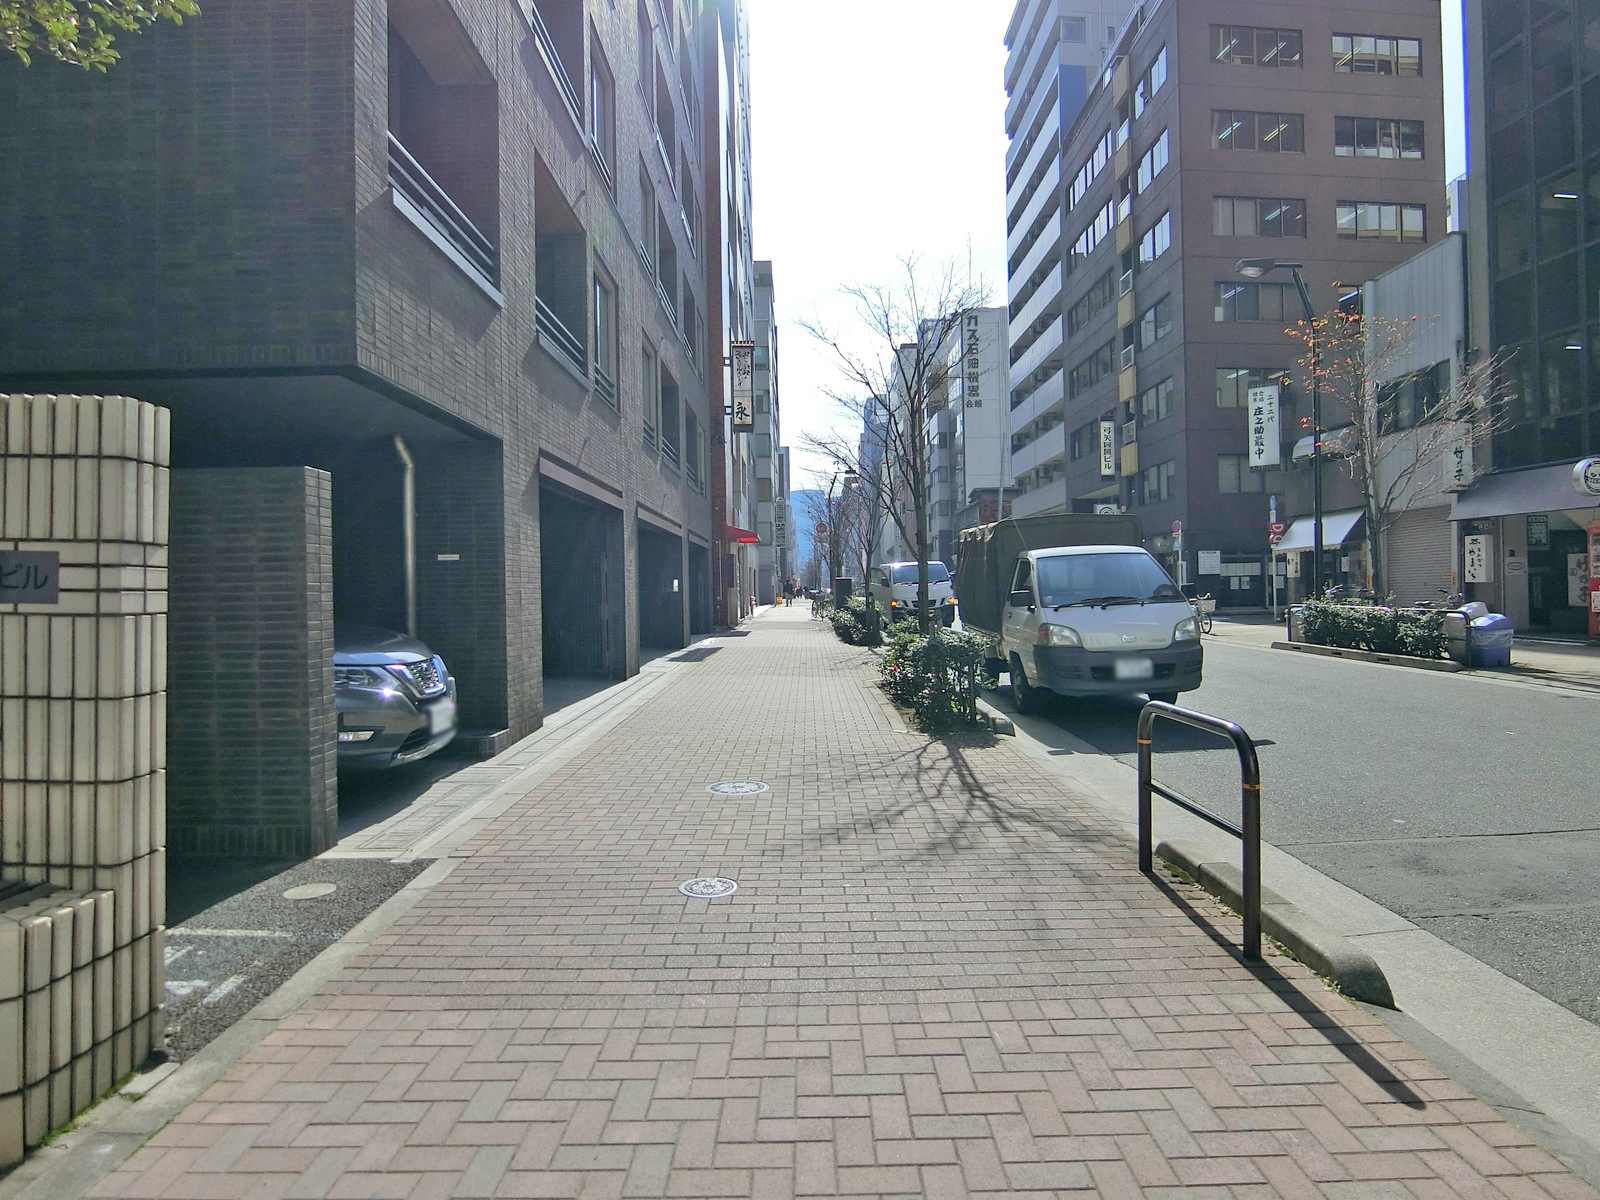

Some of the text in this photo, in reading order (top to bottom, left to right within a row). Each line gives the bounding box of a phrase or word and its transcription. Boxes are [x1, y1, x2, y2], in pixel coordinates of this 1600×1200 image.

[735, 401, 750, 421] 永
[1267, 394, 1275, 423] 二十二代
[1253, 405, 1265, 460] 庄之助最中
[1453, 445, 1465, 481] 竹の子
[1468, 548, 1477, 580] やまいち
